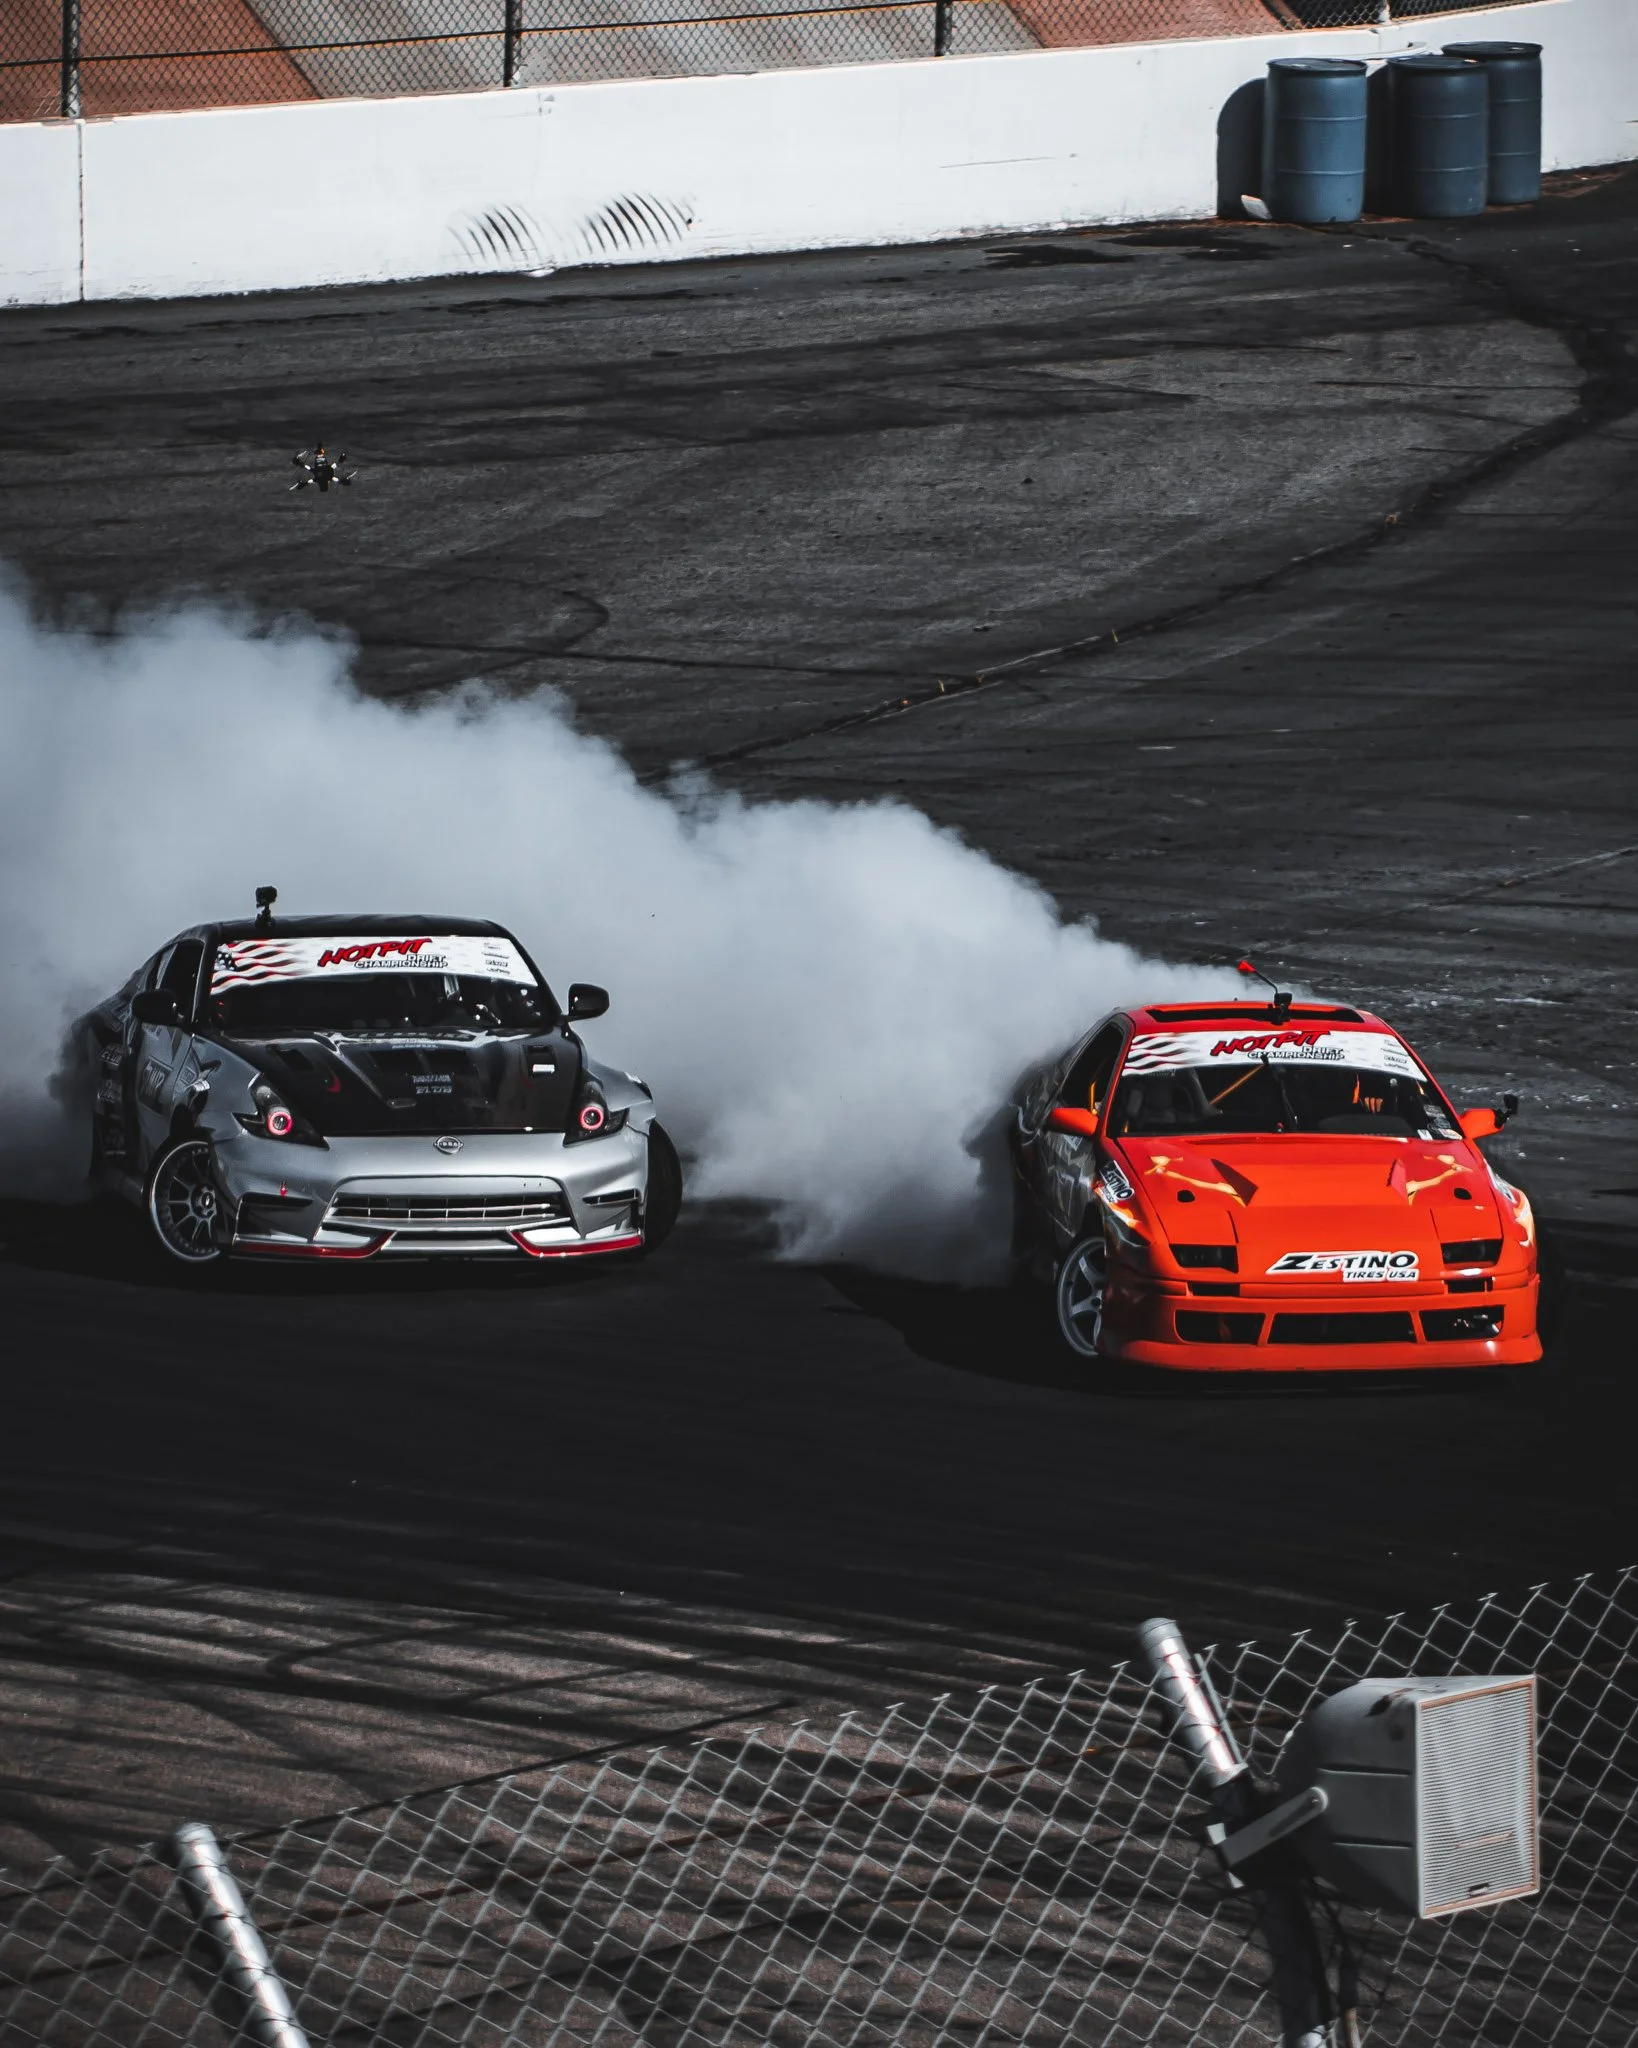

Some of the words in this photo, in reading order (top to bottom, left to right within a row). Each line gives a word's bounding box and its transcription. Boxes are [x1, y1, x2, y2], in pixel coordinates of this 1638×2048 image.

[317, 938, 433, 967] HOTPIT
[407, 954, 446, 962] DRIFT
[354, 960, 448, 969] CHAMPIONSHIP
[1210, 1031, 1331, 1056] HOTPIT
[1302, 1046, 1343, 1054] DRIFT
[1248, 1051, 1345, 1060] CHAMPIONSHIP
[1272, 1253, 1416, 1270] ZESTINO
[1346, 1271, 1385, 1279] TIRES
